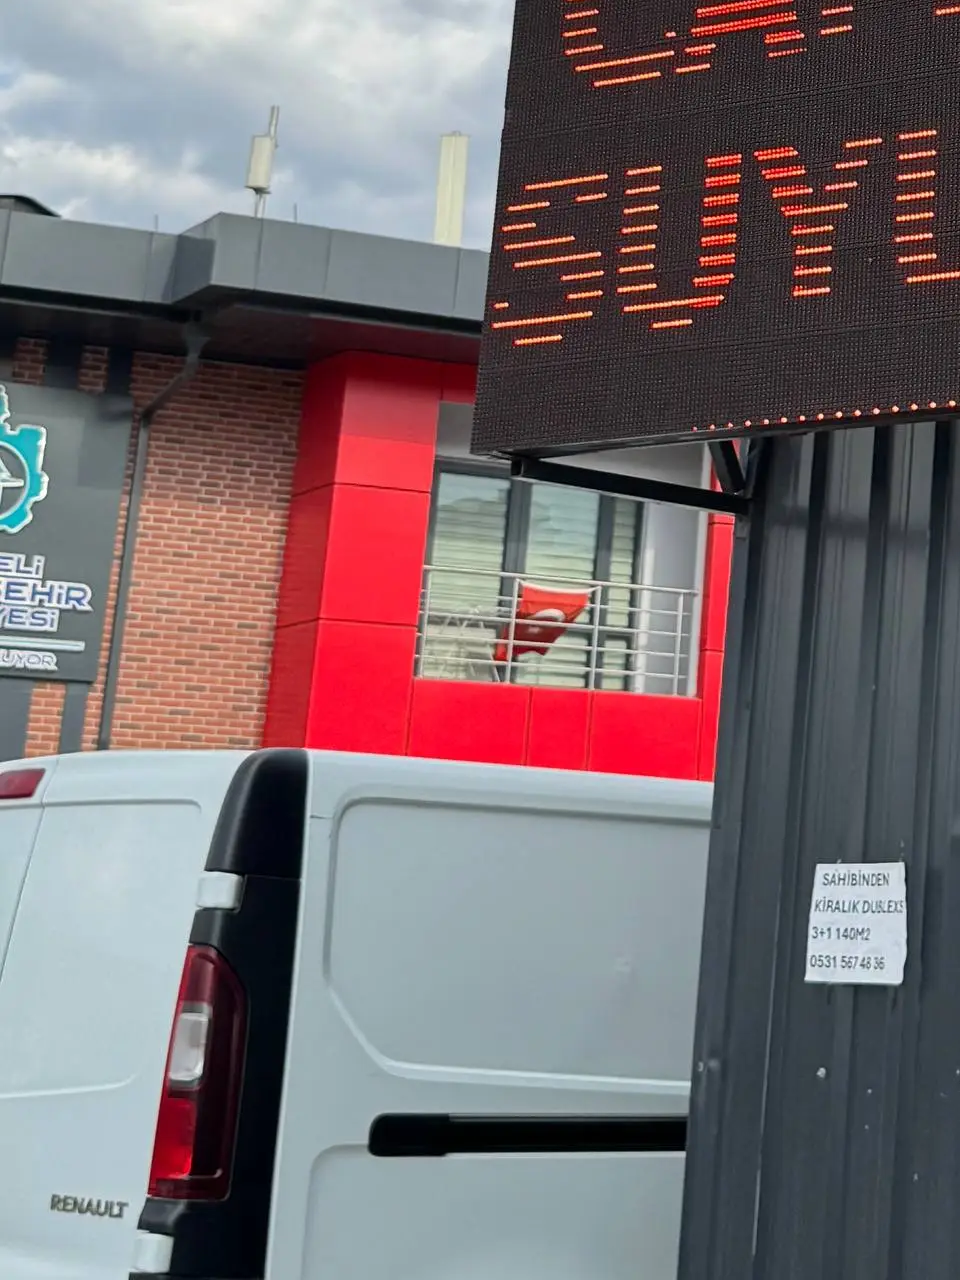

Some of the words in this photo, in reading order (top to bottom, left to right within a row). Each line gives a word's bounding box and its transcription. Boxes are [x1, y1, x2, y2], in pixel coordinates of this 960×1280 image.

[811, 926, 832, 940] 3+1
[809, 954, 838, 969] 0531
[50, 1194, 129, 1218] RENAULT
